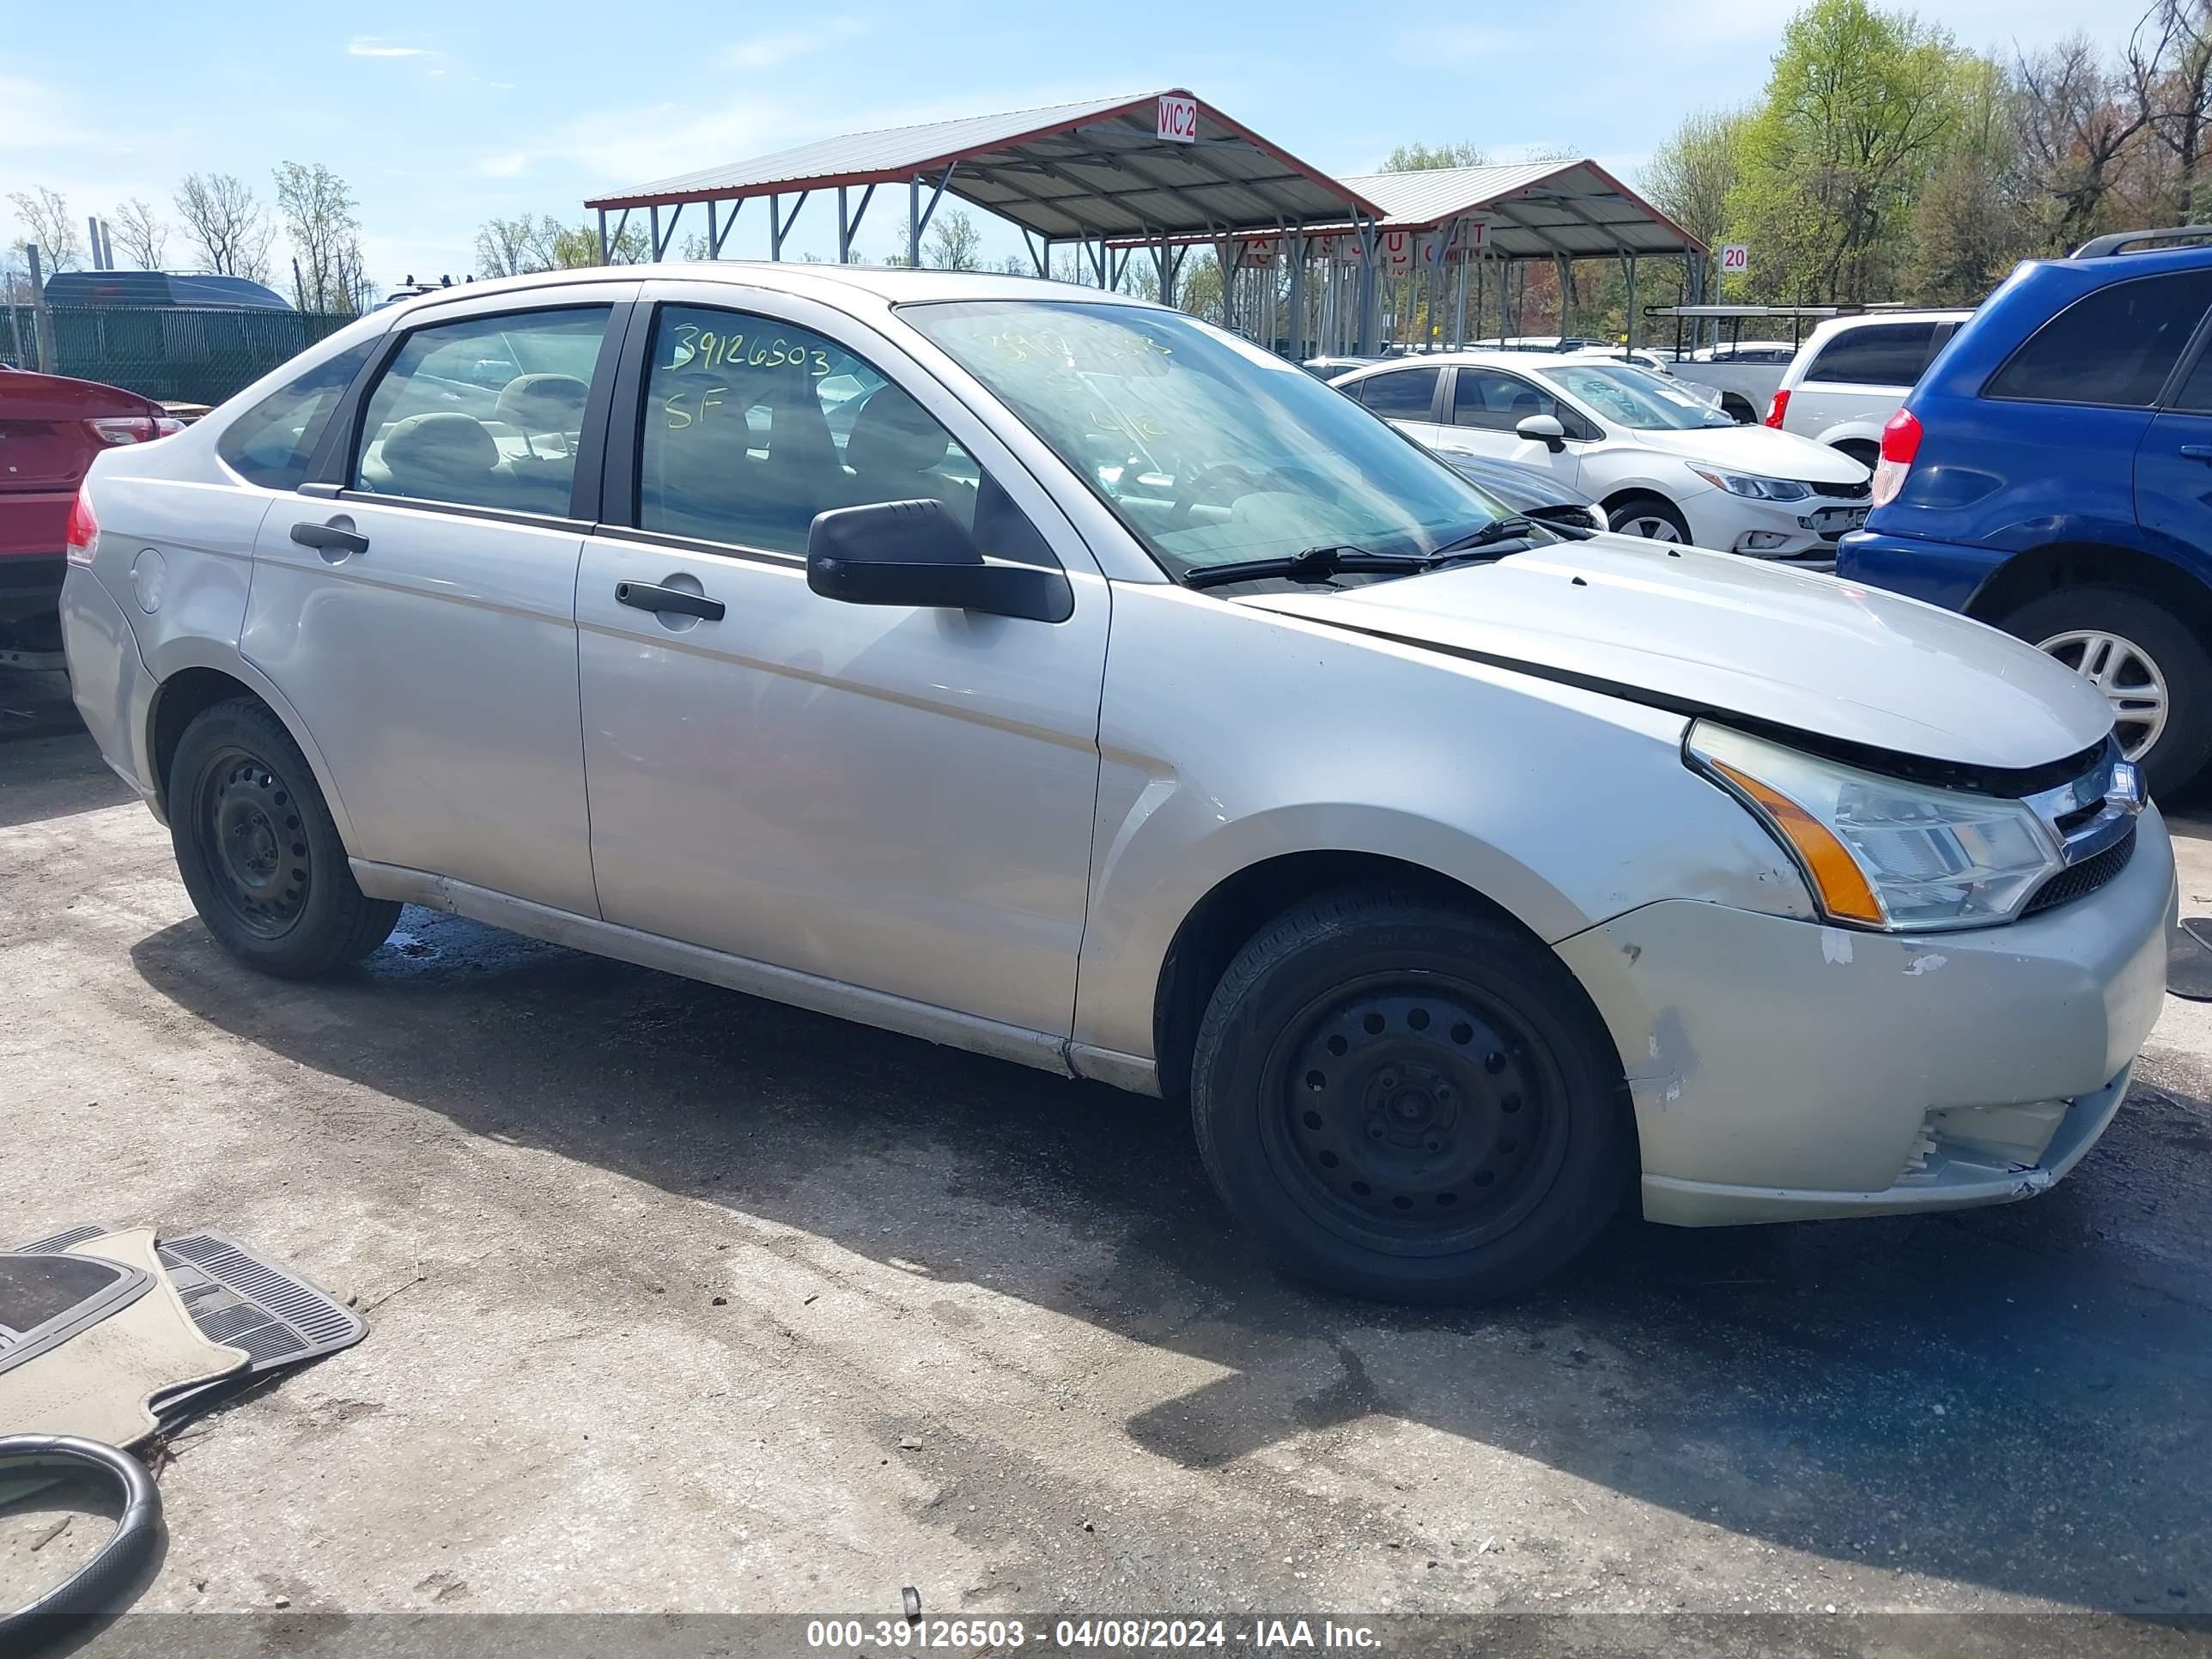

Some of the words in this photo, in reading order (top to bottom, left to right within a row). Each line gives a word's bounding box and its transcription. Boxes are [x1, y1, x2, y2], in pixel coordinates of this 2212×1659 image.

[1160, 101, 1183, 135] VIC
[1186, 106, 1194, 136] 2
[1388, 233, 1403, 252] U
[1474, 222, 1486, 244] T
[1724, 248, 1745, 267] 20
[662, 323, 830, 376] 39126503
